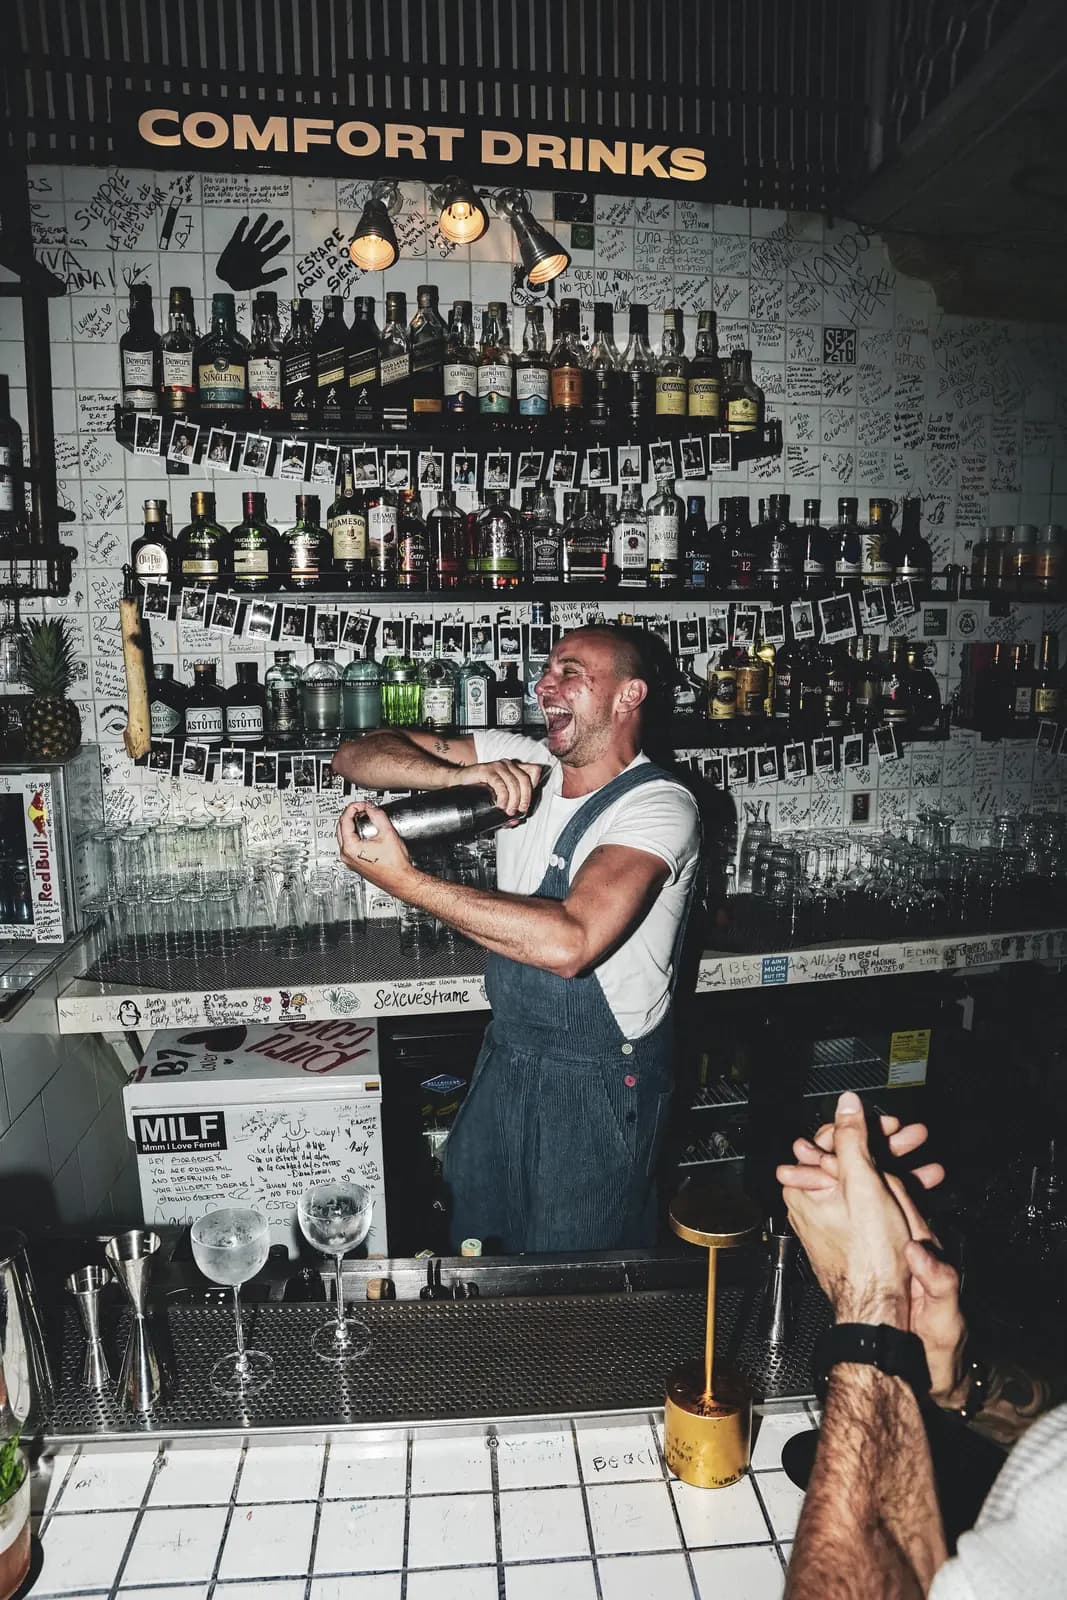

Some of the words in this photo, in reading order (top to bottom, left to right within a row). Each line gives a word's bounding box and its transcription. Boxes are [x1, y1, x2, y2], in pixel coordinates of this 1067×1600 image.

[138, 109, 465, 162] COMFORT
[481, 129, 708, 182] DRINKS
[327, 237, 351, 269] PO
[560, 283, 572, 293] NO
[203, 372, 241, 383] SINGLETON
[206, 391, 217, 400] 12
[741, 562, 751, 570] 12
[187, 720, 222, 730] ASTUTTO
[227, 717, 262, 728] ASTUTTO
[32, 840, 50, 870] Bull
[35, 872, 52, 901] Red
[849, 946, 880, 961] need
[373, 986, 470, 1010] Sexcuéstrame
[139, 1115, 218, 1143] MILF
[172, 1142, 192, 1150] Love
[194, 1140, 220, 1149] Fernet
